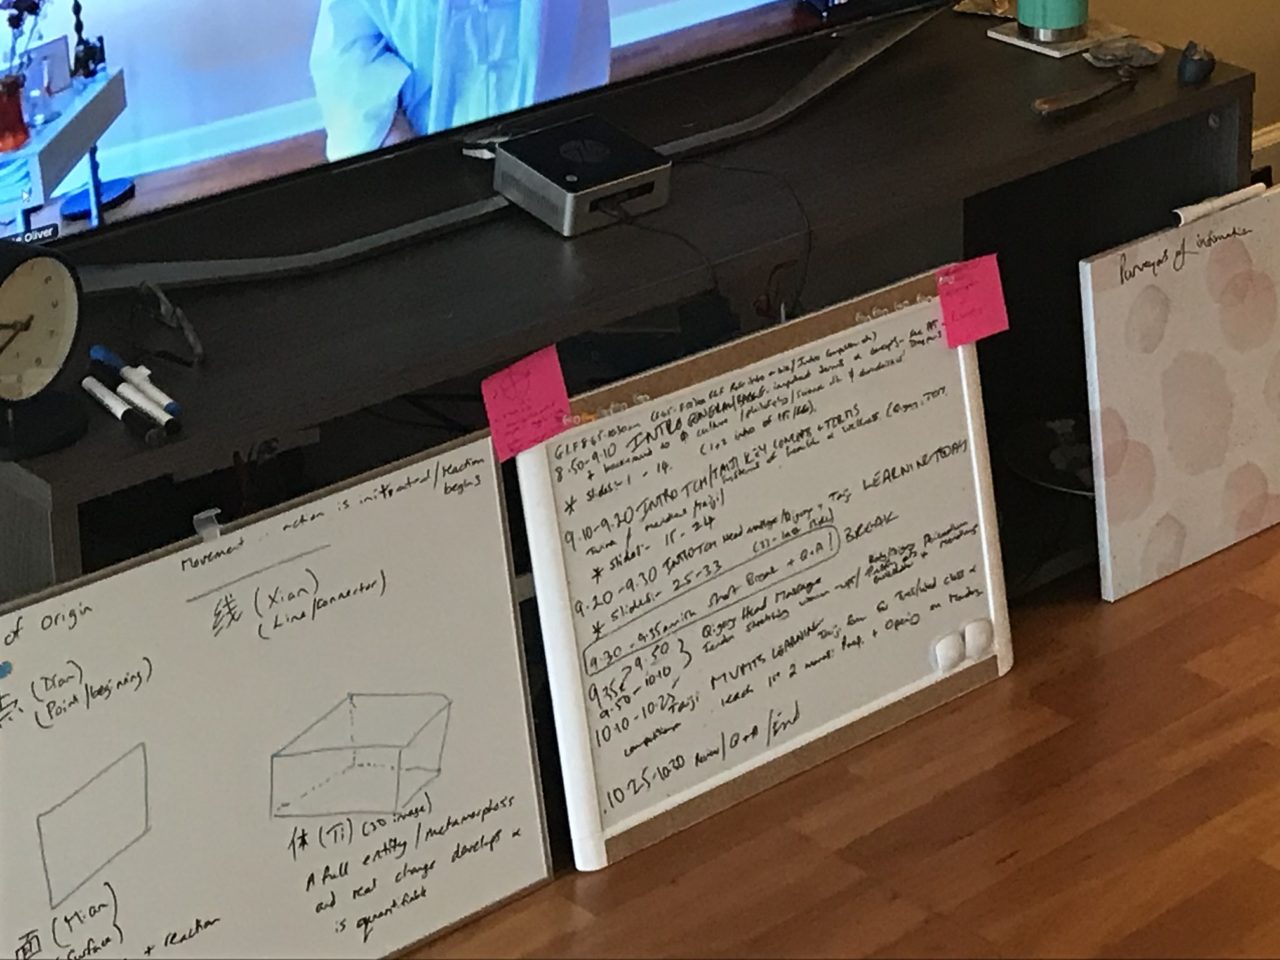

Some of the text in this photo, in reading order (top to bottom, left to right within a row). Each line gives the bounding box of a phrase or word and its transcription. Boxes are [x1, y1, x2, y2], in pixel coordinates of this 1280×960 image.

[24, 227, 54, 243] Oliver
[1173, 238, 1198, 272] of
[624, 416, 683, 454] INTRO
[444, 476, 482, 496] begins
[181, 538, 245, 572] Movement
[283, 511, 325, 532] action
[338, 499, 350, 512] is
[843, 511, 900, 544] BREAK
[671, 558, 723, 591] 25-33
[741, 596, 768, 621] Head
[774, 576, 823, 604] Massage
[4, 602, 93, 646] of origin
[213, 593, 244, 638] 线
[788, 663, 798, 679] 2
[305, 872, 315, 892] A
[321, 861, 349, 882] full
[315, 891, 336, 914] and
[334, 919, 347, 933] is
